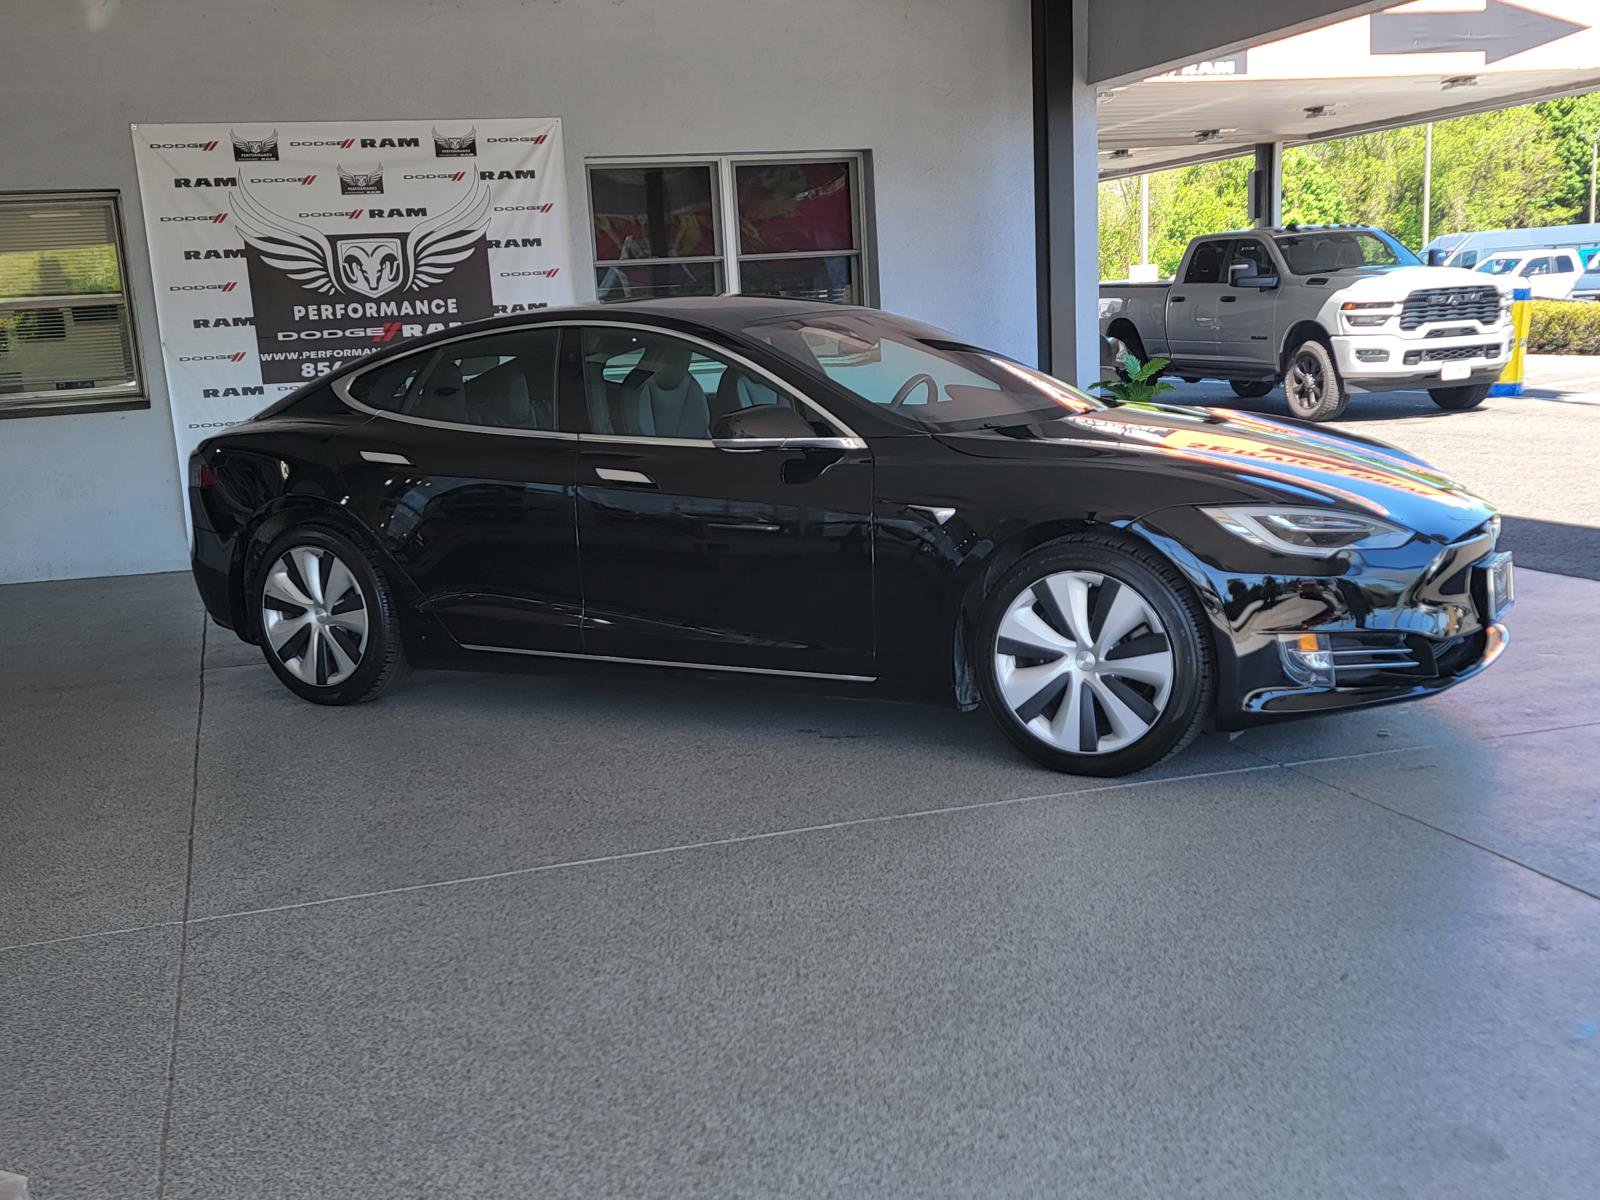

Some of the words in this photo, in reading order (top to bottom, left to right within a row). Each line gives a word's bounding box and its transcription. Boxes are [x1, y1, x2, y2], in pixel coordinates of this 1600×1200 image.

[1181, 61, 1236, 75] RAM
[360, 138, 420, 148] RAM
[479, 170, 536, 180] RAM
[174, 178, 237, 188] RAM
[368, 208, 428, 218] RAM
[487, 238, 542, 248] RAM
[184, 249, 247, 260] RAM
[293, 298, 458, 320] PERFORMANCE
[492, 302, 548, 314] RAM
[193, 317, 256, 328] RAM
[277, 327, 386, 341] DODGE
[202, 386, 264, 398] RAM
